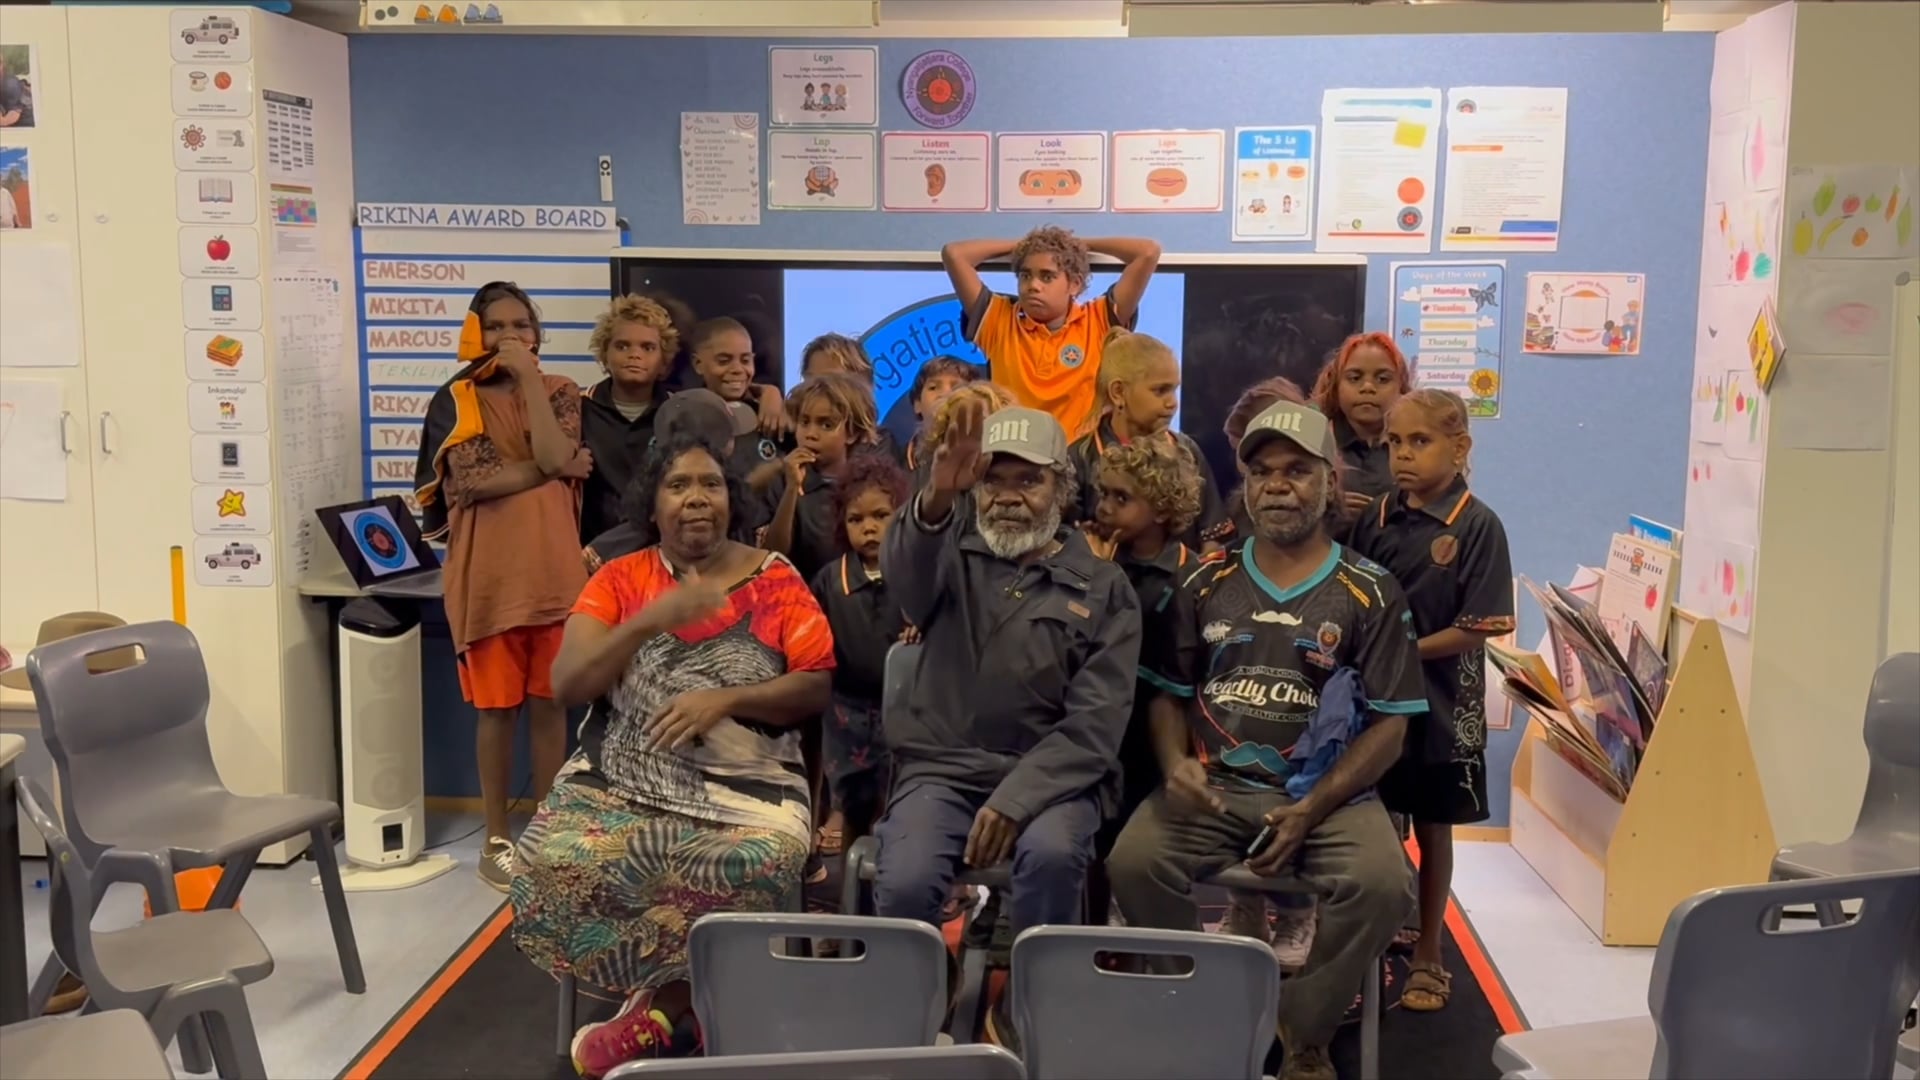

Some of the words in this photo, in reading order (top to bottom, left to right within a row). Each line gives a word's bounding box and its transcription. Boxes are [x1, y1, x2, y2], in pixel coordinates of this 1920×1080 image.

[814, 53, 834, 64] Legs
[813, 137, 831, 147] Lap
[921, 139, 950, 149] Listen
[1040, 139, 1062, 148] Look
[1254, 135, 1272, 145] The
[1275, 134, 1282, 145] 5
[359, 206, 440, 225] RIKINA
[447, 207, 526, 228] AWARD
[536, 208, 607, 229] BOARD
[365, 261, 466, 282] EMERSON
[1433, 287, 1467, 296] Monday
[369, 297, 448, 316] MIKITA
[369, 330, 453, 348] MARCUS
[1428, 337, 1468, 347] Thursday
[873, 316, 960, 390] gatja
[1433, 354, 1461, 364] Friday
[1426, 371, 1467, 381] Saturday
[1260, 412, 1302, 432] ant
[379, 428, 423, 446] TYA
[988, 418, 1031, 445] ant
[377, 461, 416, 479] NIK
[1269, 681, 1320, 709] Choic
